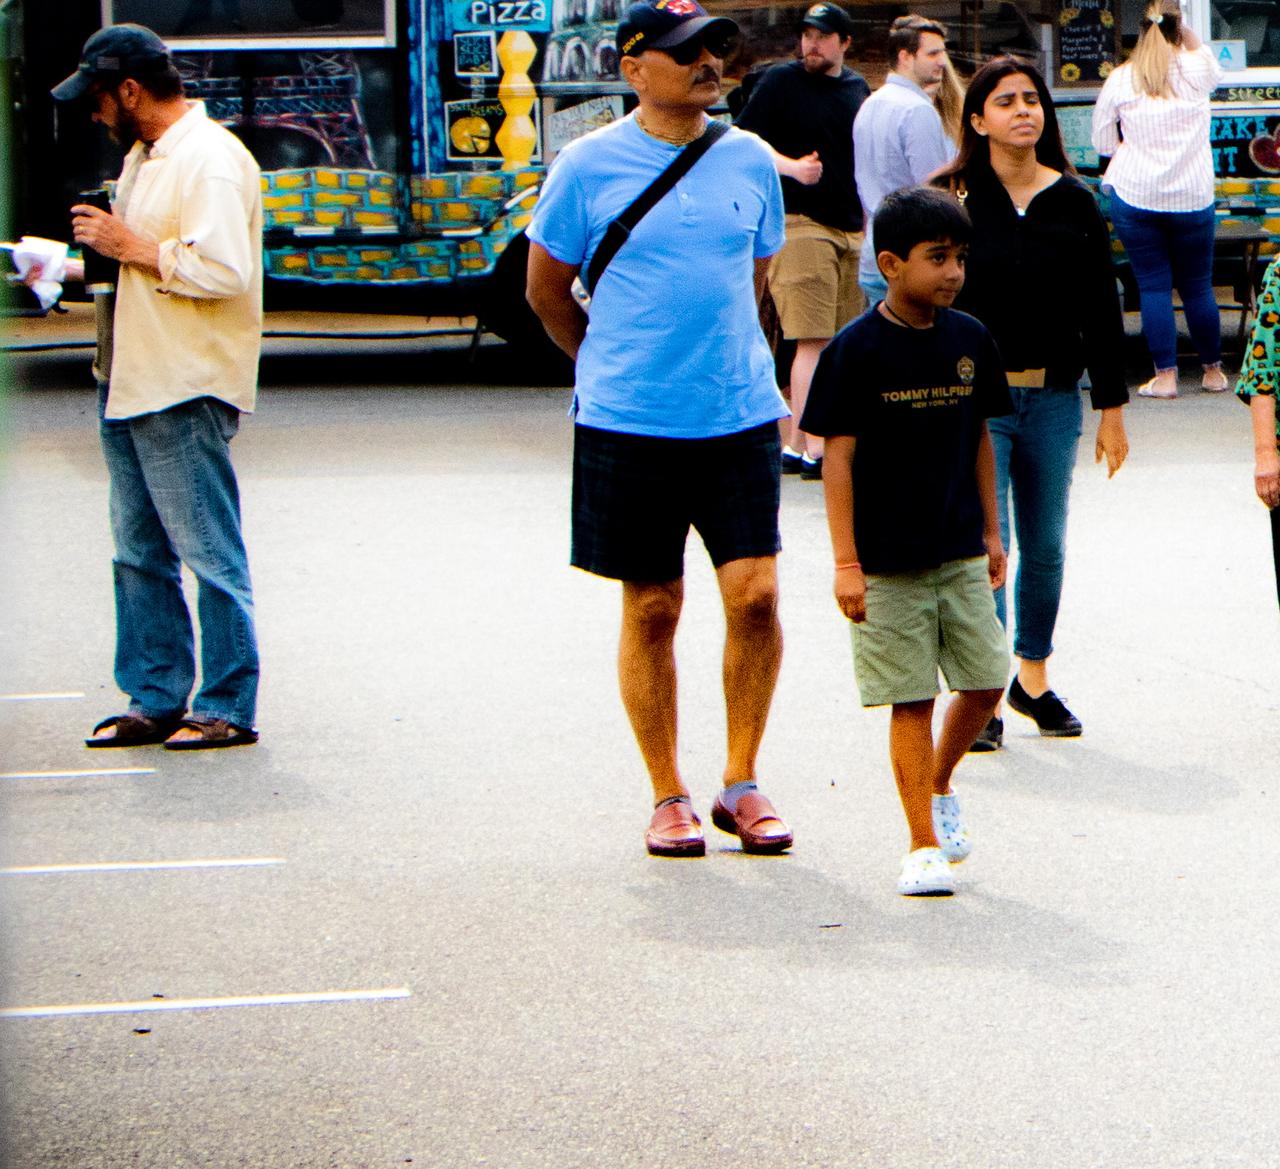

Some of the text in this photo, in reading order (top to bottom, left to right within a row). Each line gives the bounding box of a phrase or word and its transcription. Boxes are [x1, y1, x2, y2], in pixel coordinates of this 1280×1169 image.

[471, 0, 546, 25] Pizza
[1218, 46, 1233, 61] A
[1211, 116, 1269, 142] TAKE
[1212, 147, 1238, 173] IT
[881, 388, 929, 403] TOMMY
